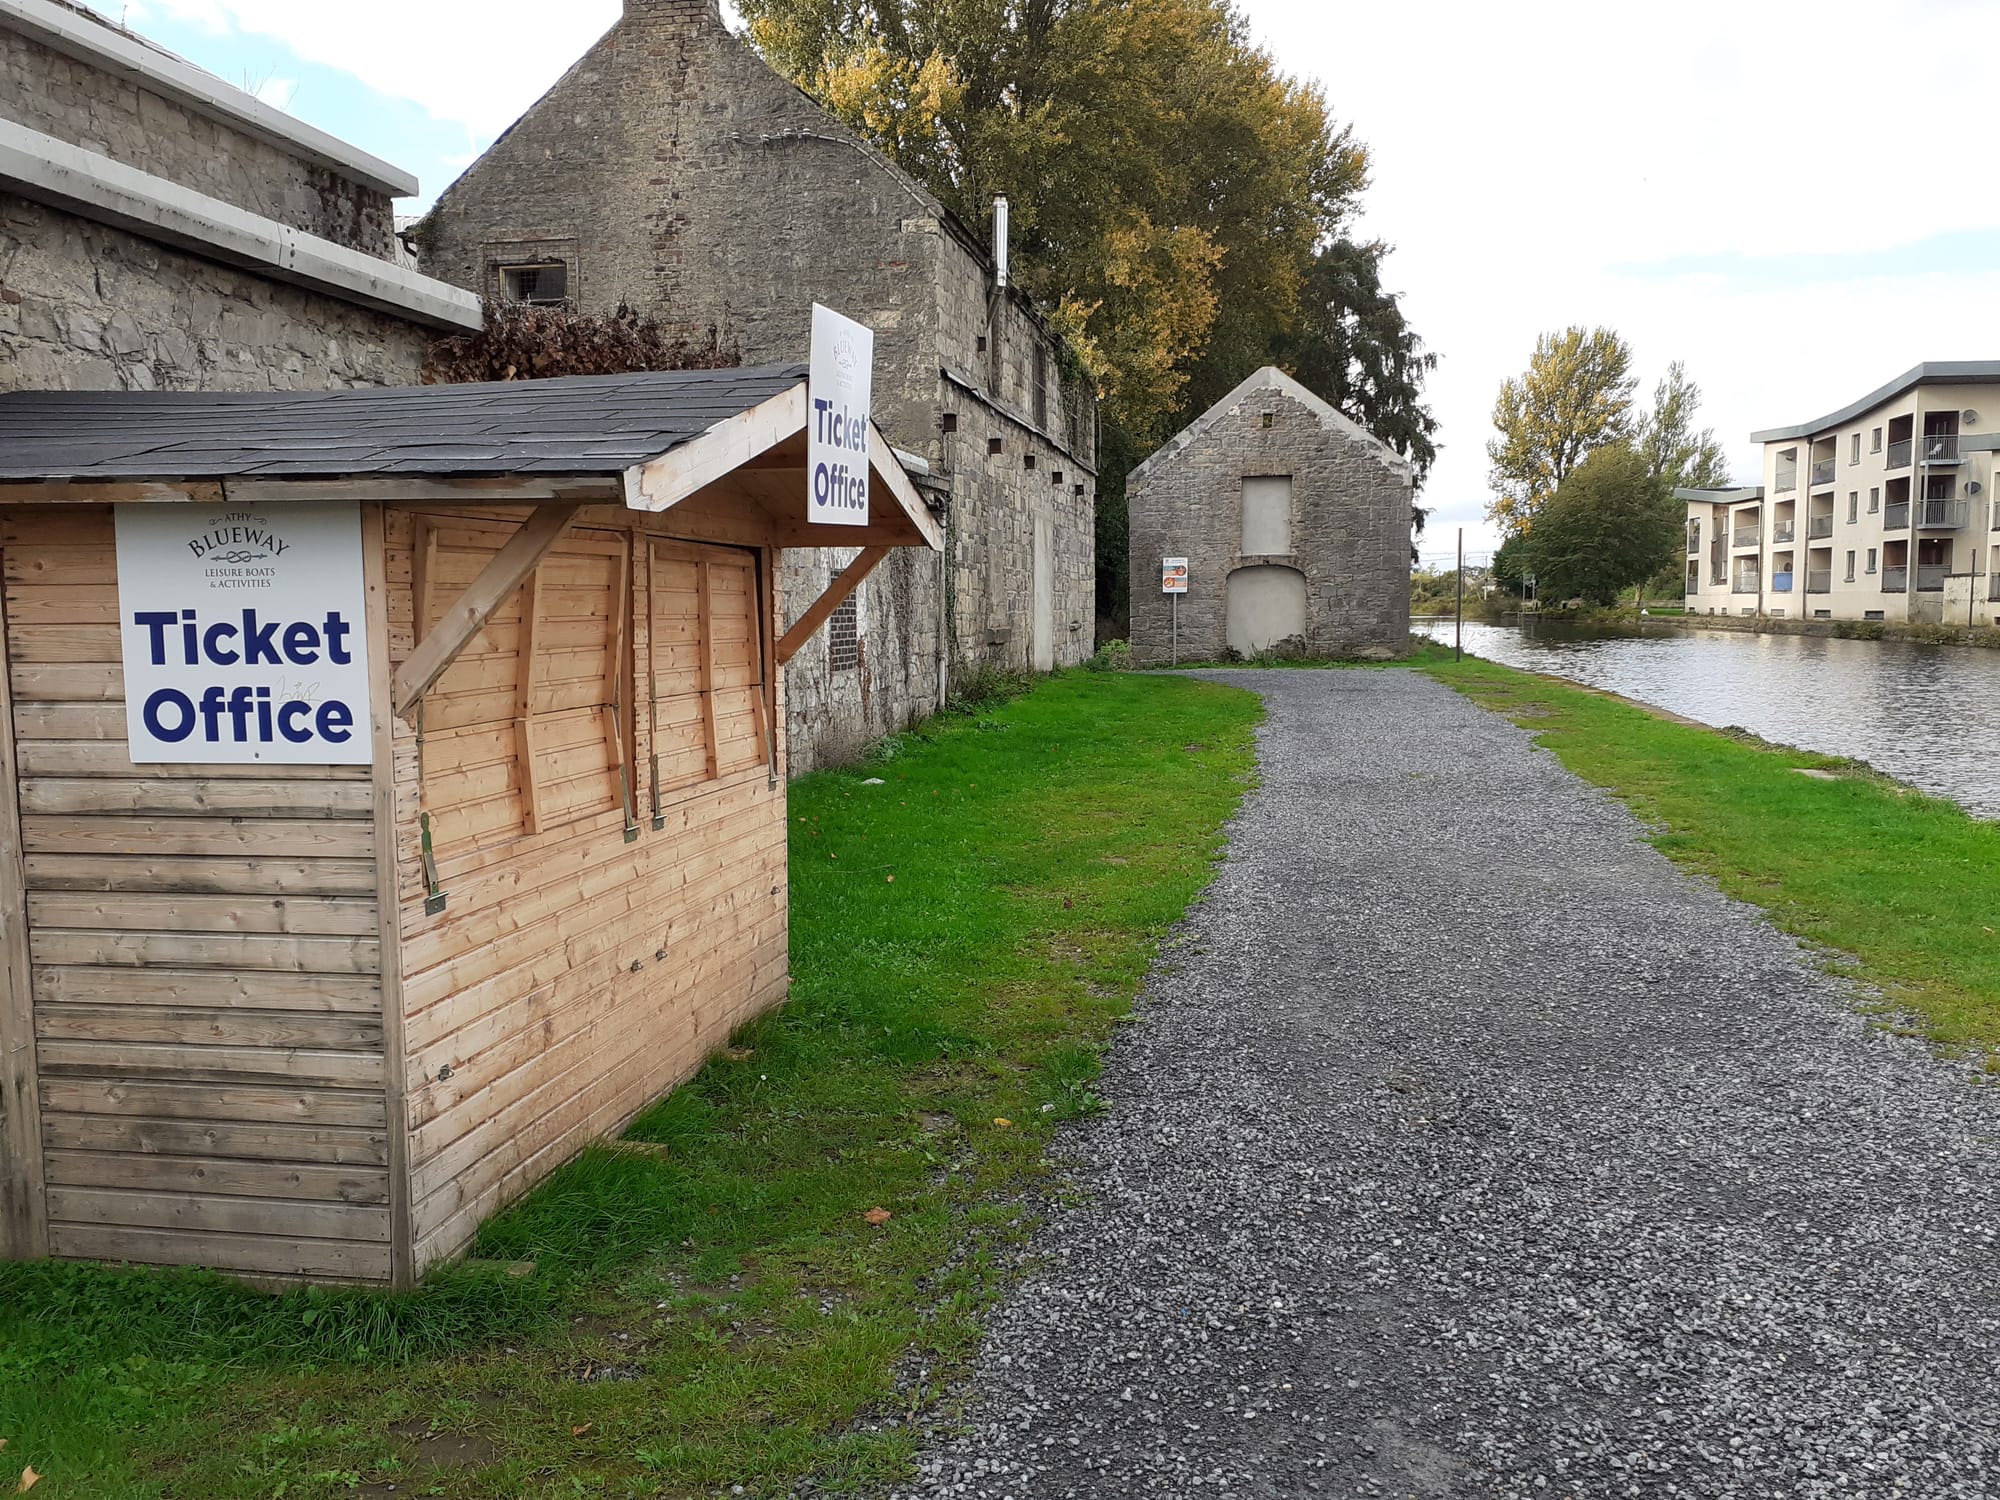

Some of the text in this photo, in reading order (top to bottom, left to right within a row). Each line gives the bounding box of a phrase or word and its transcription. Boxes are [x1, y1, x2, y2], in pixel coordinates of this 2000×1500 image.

[814, 398, 866, 453] Ticket
[814, 462, 865, 510] Office
[225, 513, 252, 522] ATHY
[187, 527, 290, 559] BLUEWAY
[205, 567, 276, 578] LEISURE BOATS
[218, 579, 271, 588] ACTIVITIES
[134, 608, 351, 666] Ticket
[143, 686, 353, 743] Office
